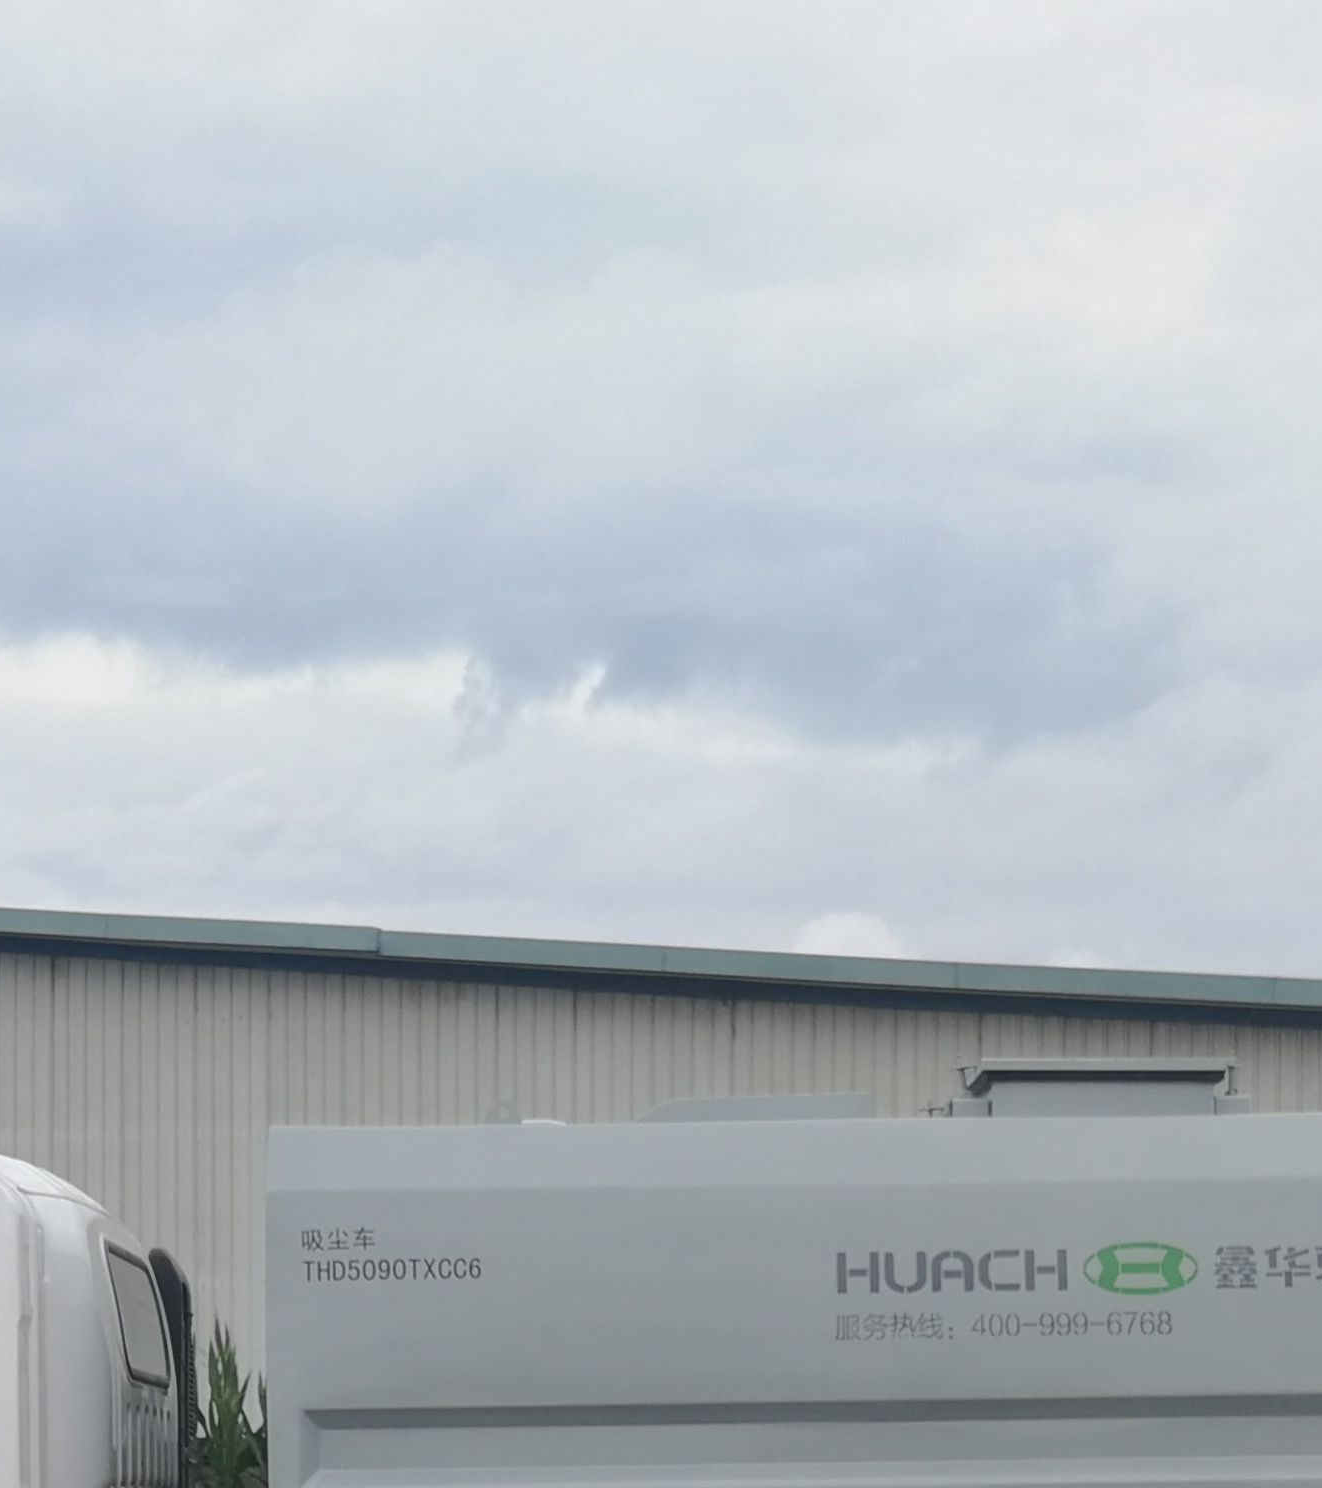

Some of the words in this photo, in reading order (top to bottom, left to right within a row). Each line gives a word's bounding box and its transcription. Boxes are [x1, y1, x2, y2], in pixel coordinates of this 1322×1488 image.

[301, 1227, 375, 1252] 吸尘车
[303, 1257, 482, 1282] THD5090TXCC6
[836, 1249, 1068, 1295] HUACH
